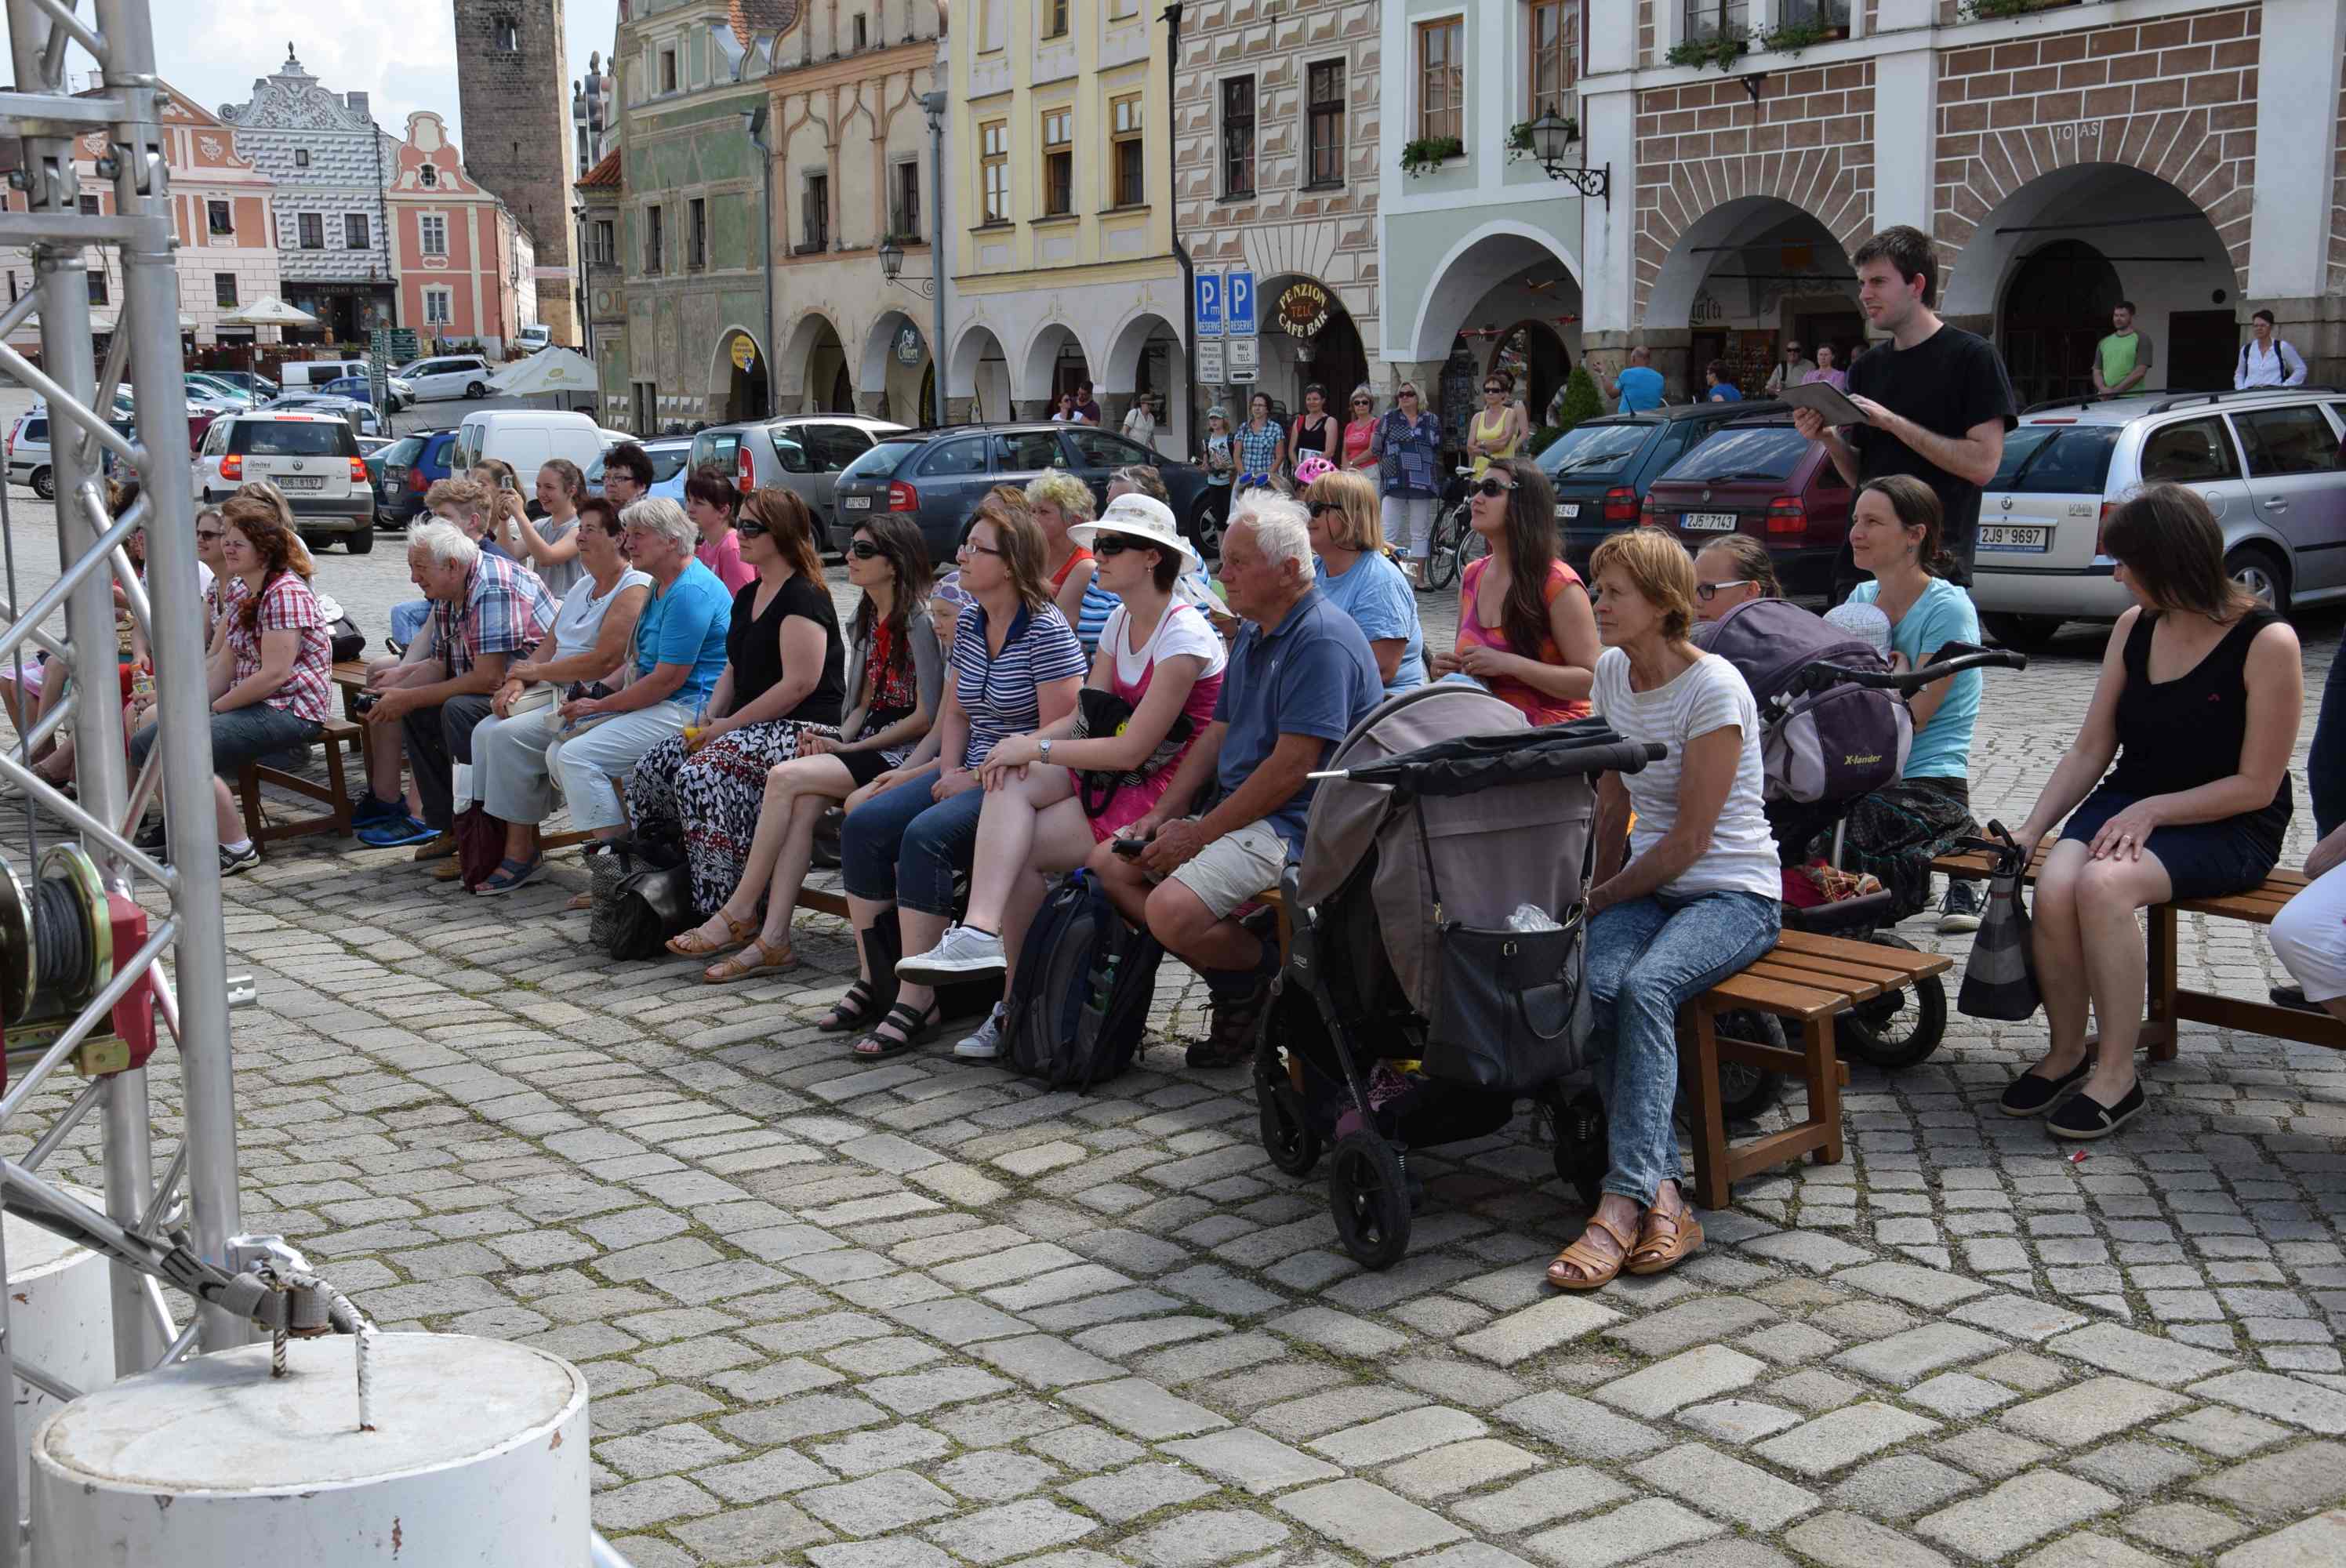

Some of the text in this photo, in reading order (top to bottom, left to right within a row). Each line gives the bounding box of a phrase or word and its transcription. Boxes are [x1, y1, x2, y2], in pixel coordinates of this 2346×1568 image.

[1202, 281, 1215, 315] P
[1233, 279, 1247, 314] P
[1279, 283, 1327, 310] PENZION
[1306, 310, 1328, 336] BAR
[1687, 515, 1732, 528] 2J5 7143
[1981, 528, 2040, 544] 2J9 9697
[1843, 753, 1883, 766] X-lander
